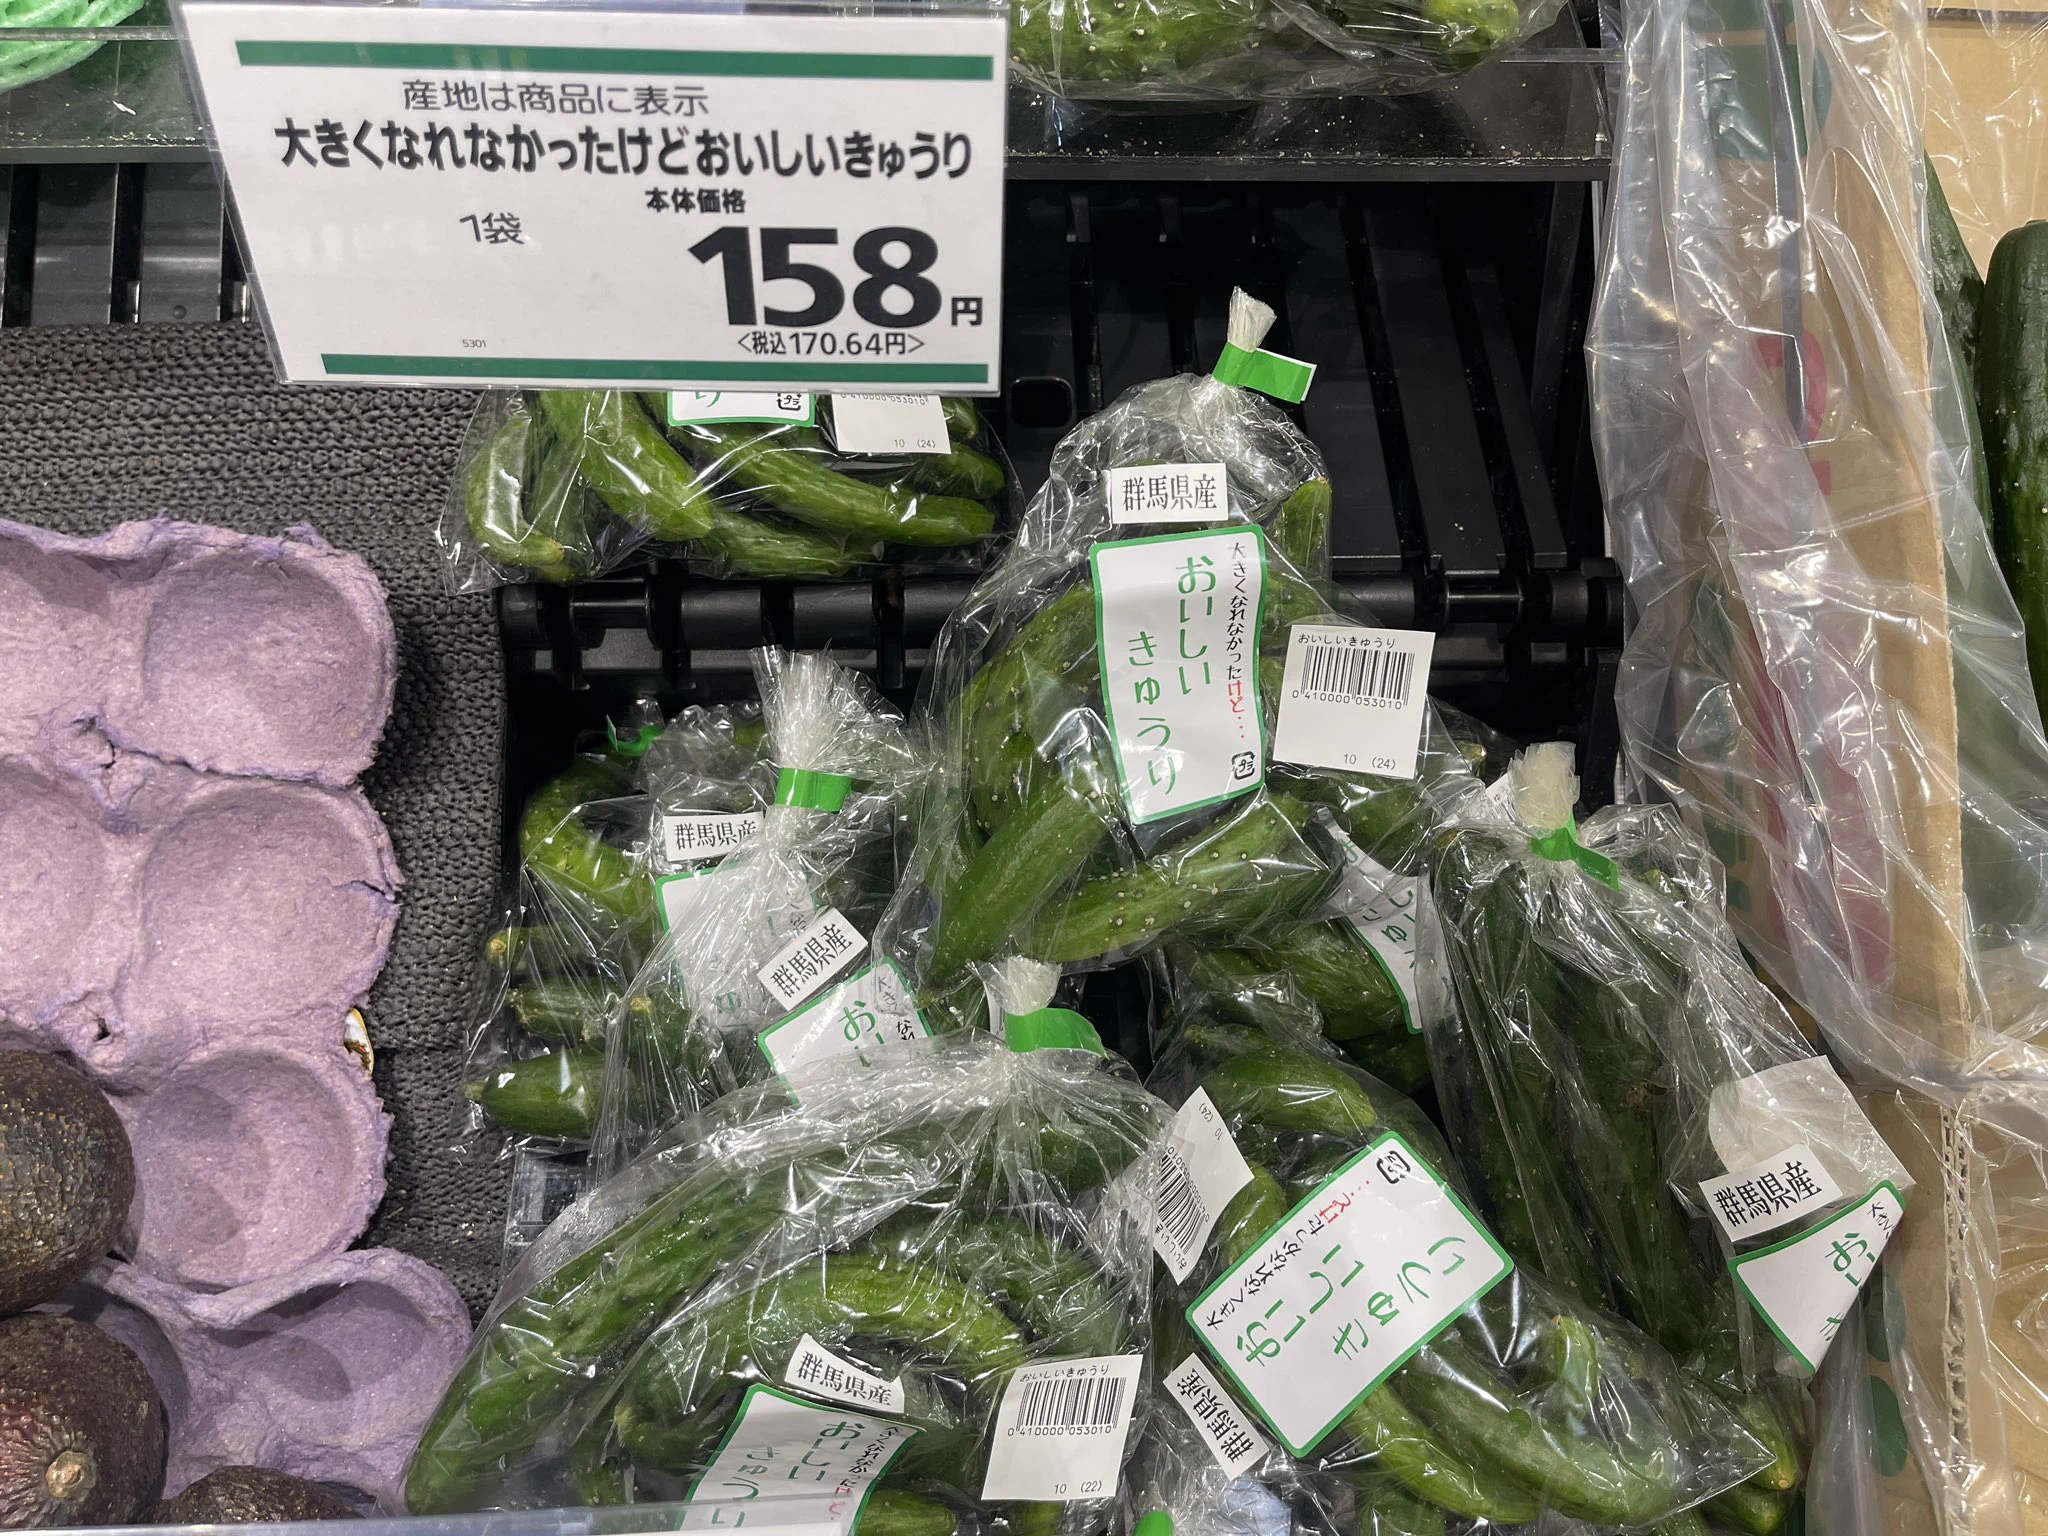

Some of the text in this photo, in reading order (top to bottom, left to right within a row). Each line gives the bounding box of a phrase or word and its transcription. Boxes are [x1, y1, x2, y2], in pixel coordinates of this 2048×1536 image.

[402, 79, 709, 116] 産地は商品に表示
[274, 117, 972, 180] 大きくなれなかったけどおいしいきゅうり
[645, 187, 746, 214] 本体価格
[459, 212, 525, 245] 1袋
[462, 339, 487, 348] 5301
[894, 439, 936, 448] 10 (24)
[1122, 473, 1217, 511] 群馬県産
[1176, 556, 1217, 695] おいしい
[1298, 633, 1395, 649] おいしいきゅうり
[1128, 631, 1176, 795] きゅうり
[1304, 690, 1350, 704] 410000
[1355, 696, 1402, 709] 053010
[1343, 754, 1396, 771] 10 (24)
[770, 923, 853, 998] 群馬県産
[1214, 1127, 1225, 1141] 10
[1713, 1160, 1823, 1228] 群馬県産
[1237, 1244, 1365, 1367] おいしい
[1332, 1236, 1466, 1361] きゅうり
[797, 1350, 892, 1406] 群馬県産
[1020, 1364, 1110, 1382] おいしいきゅうり
[1019, 1426, 1064, 1436] 410000
[1069, 1425, 1112, 1435] 053010
[1177, 1368, 1255, 1463] 群馬県産
[788, 1421, 865, 1481] おいしい
[711, 1446, 780, 1528] きゅうり
[1054, 1480, 1102, 1494] 10 (22)
